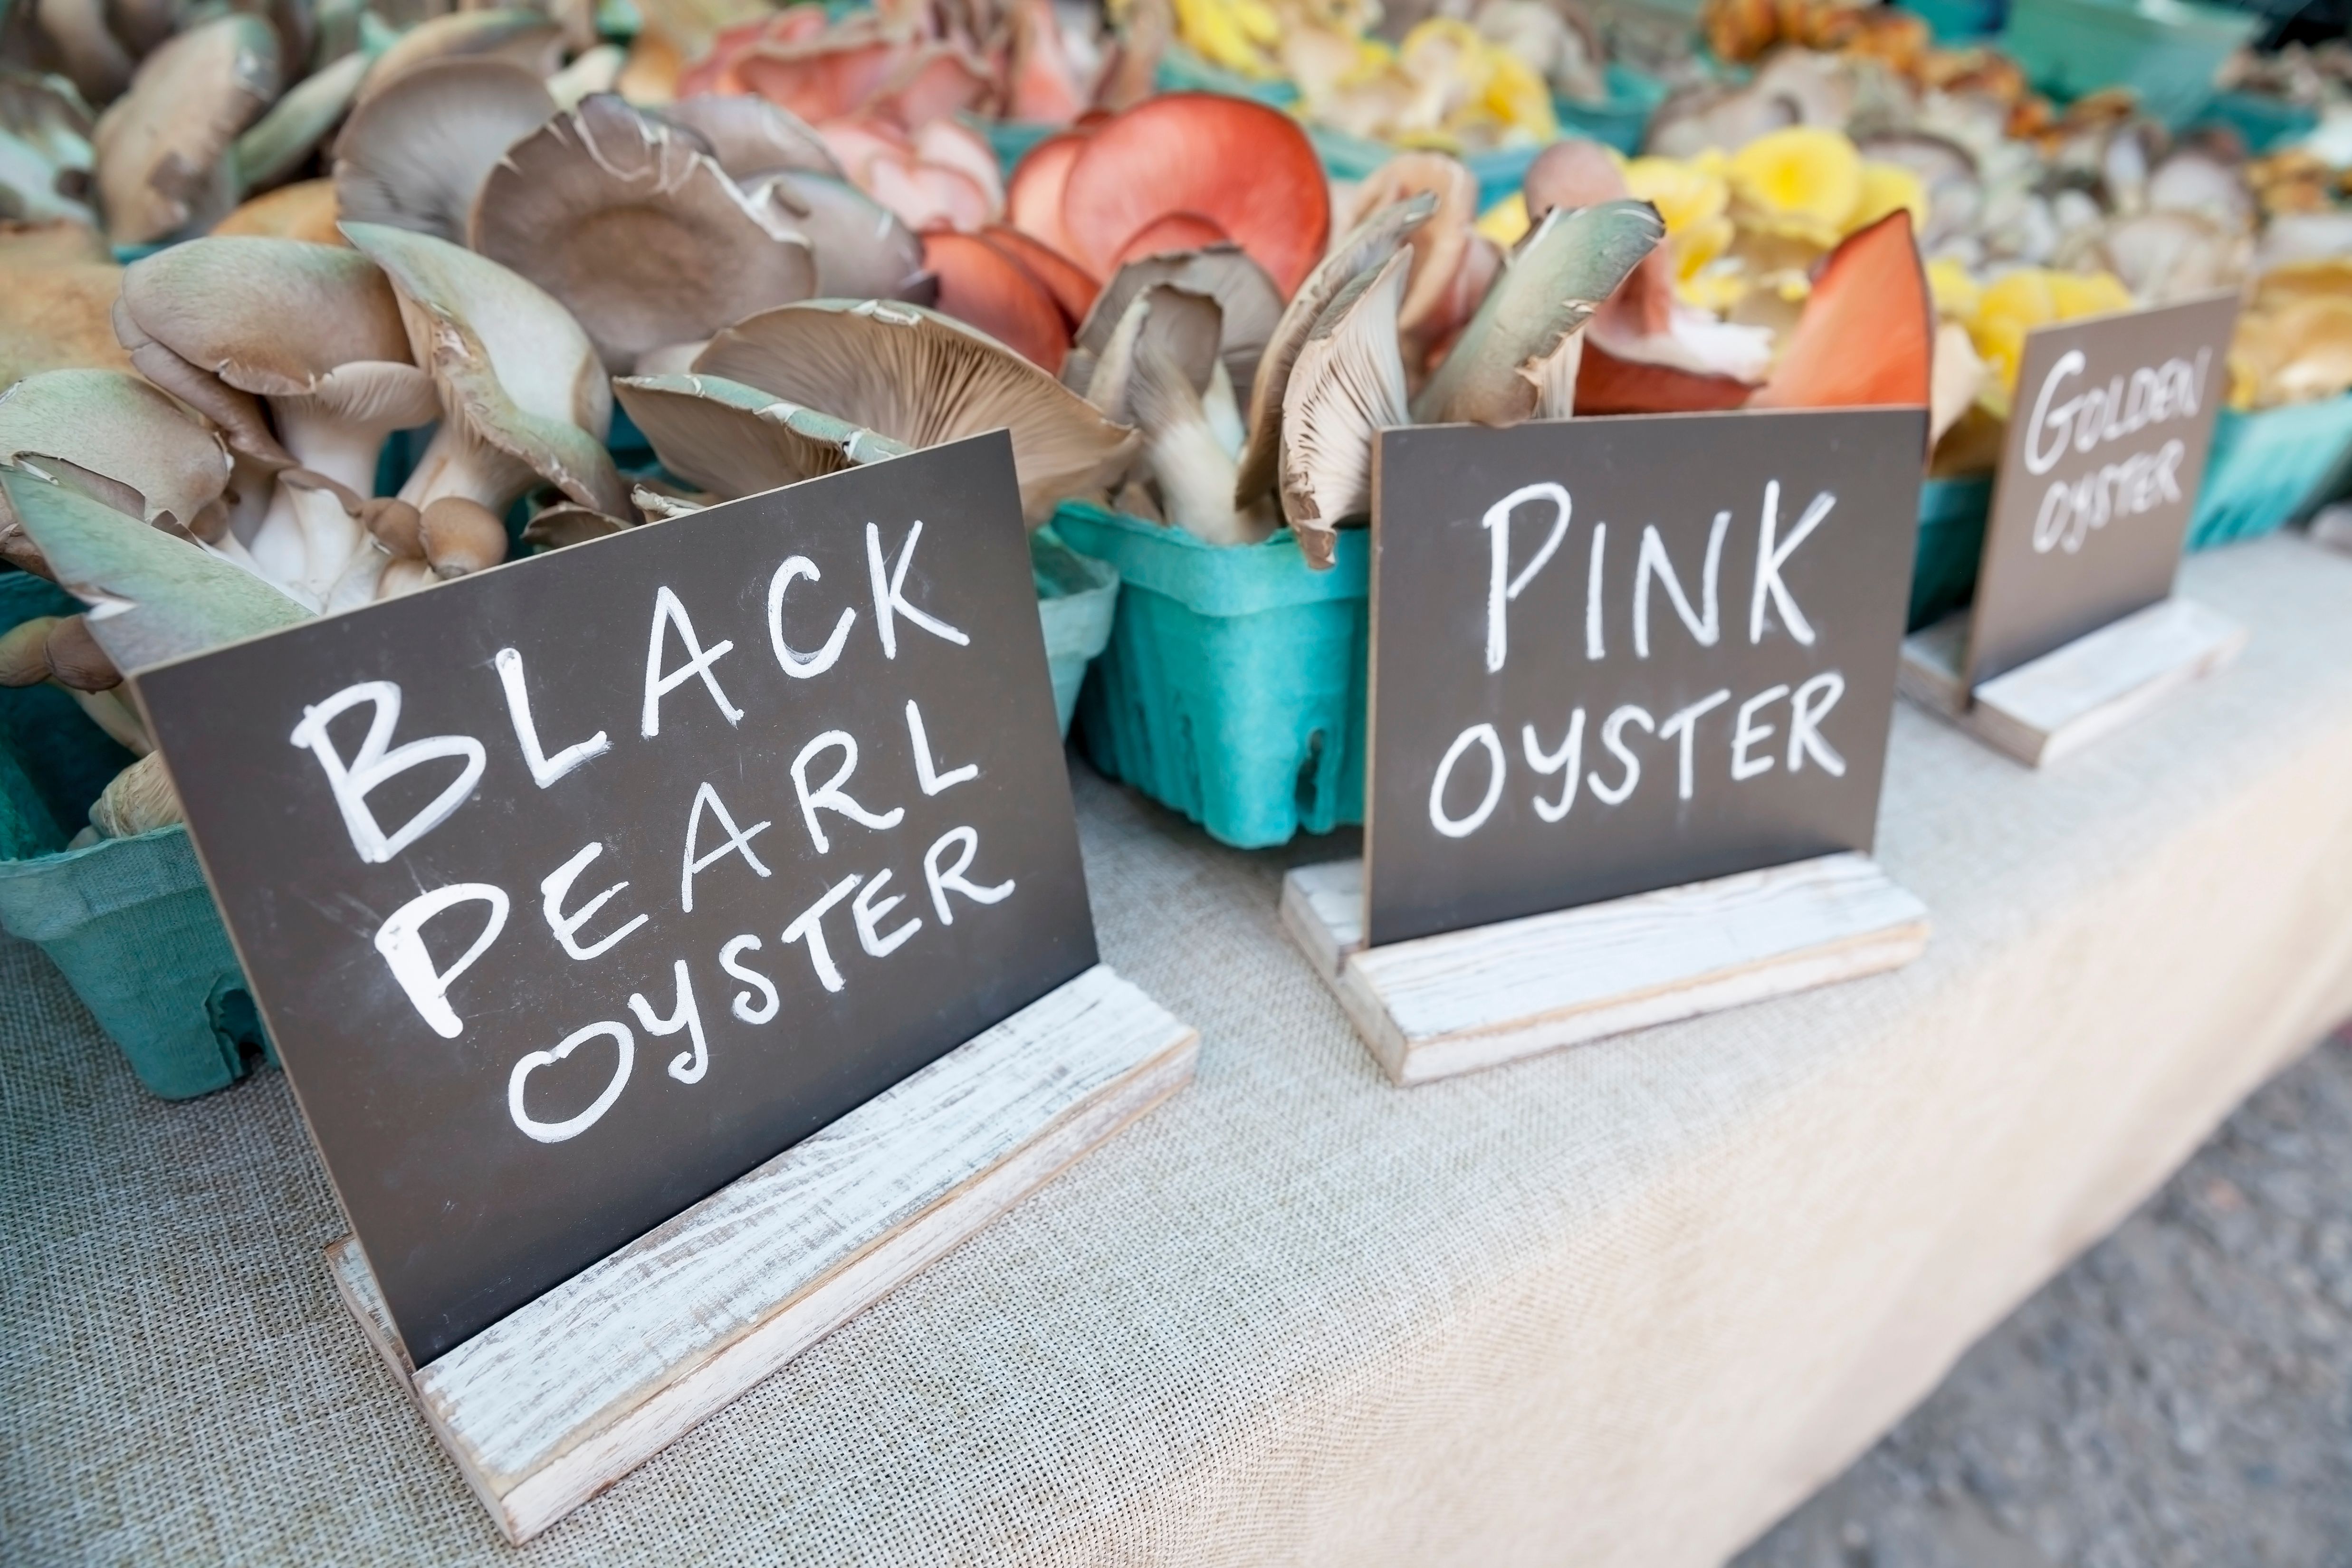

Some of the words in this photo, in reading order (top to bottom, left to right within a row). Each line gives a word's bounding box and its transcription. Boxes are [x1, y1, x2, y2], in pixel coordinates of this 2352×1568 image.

[1482, 479, 1837, 673] PINK
[2033, 438, 2185, 555] OYSTER
[290, 520, 971, 864] BLACK
[1429, 669, 1846, 838] OYSTER
[374, 699, 979, 1039] PEARL
[508, 825, 1016, 1143] OYSTER
